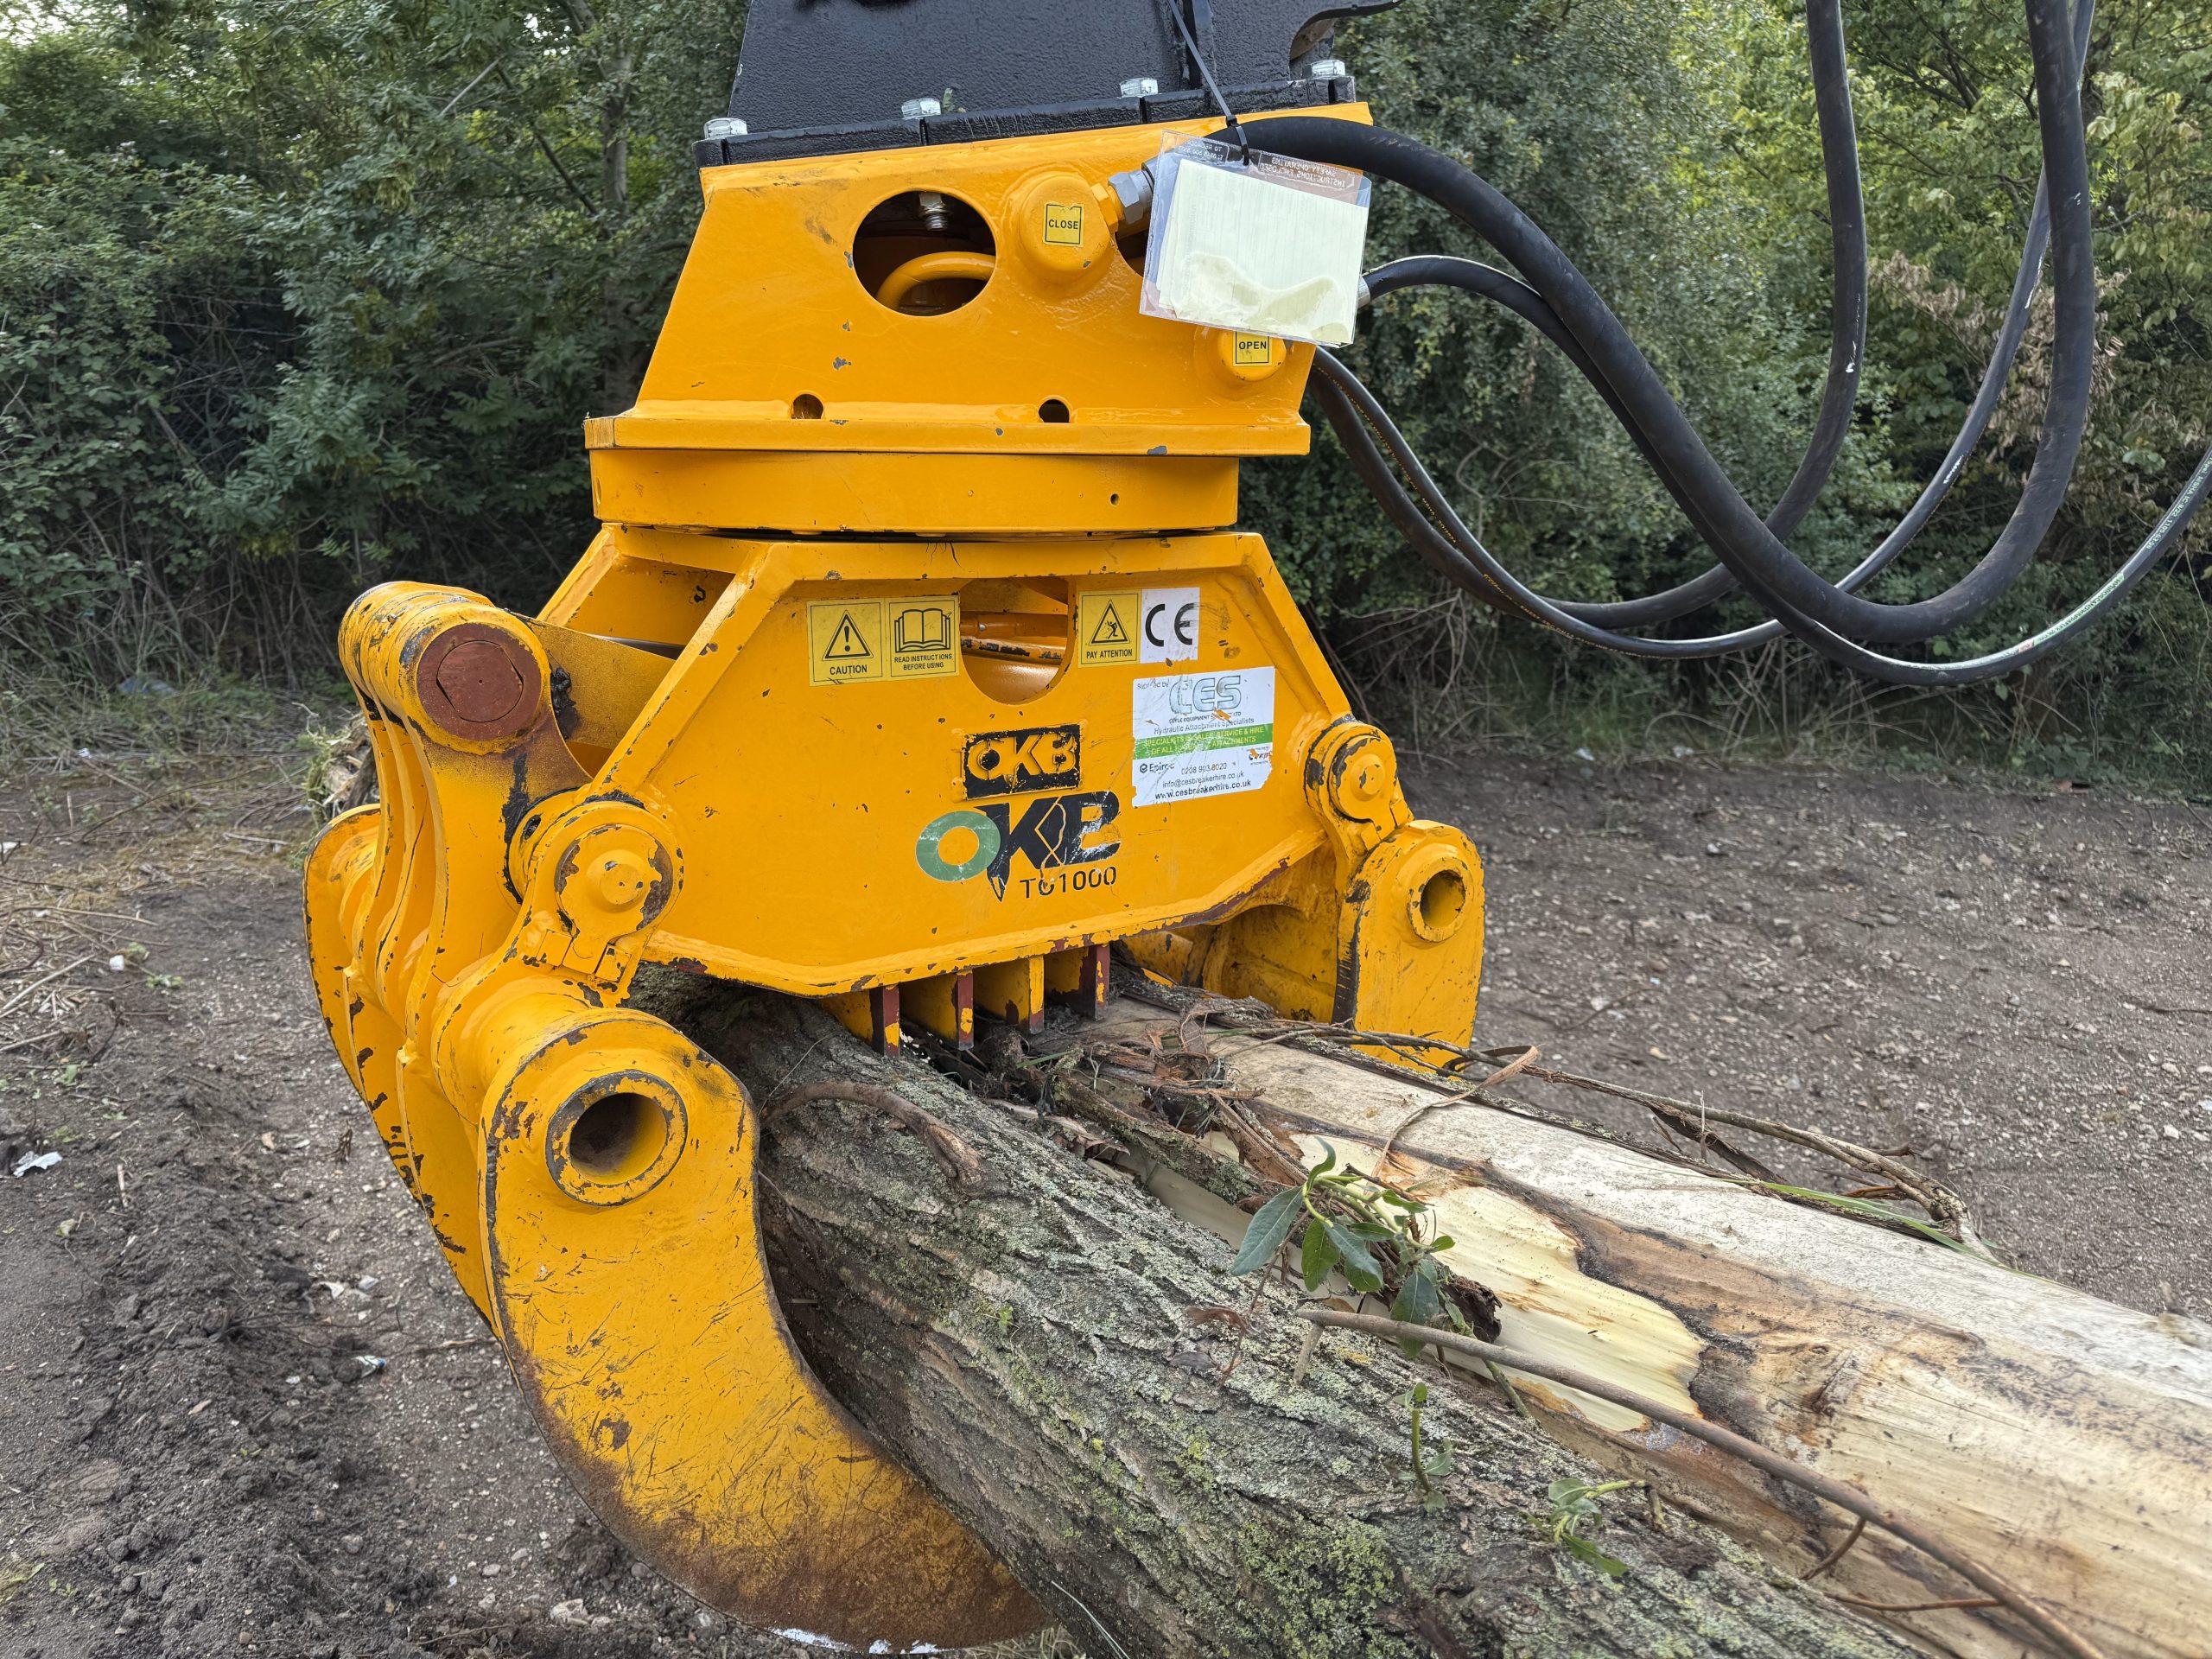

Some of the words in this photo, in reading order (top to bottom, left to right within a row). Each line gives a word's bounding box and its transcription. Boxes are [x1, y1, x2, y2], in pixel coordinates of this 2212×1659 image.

[1048, 219, 1079, 230] CLOSE
[1238, 340, 1268, 350] OPEN
[2186, 475, 2203, 495] MSHA
[1145, 601, 1195, 647] CE
[1086, 650, 1098, 659] PAY
[1100, 649, 1133, 658] ATTENTION
[830, 664, 868, 676] CAUTION
[1169, 675, 1242, 715] CES
[1154, 725, 1184, 734] Hydraulic
[1185, 721, 1221, 732] Attachment
[1222, 718, 1255, 728] Specialists
[1217, 729, 1243, 738] SERVICE
[1211, 737, 1256, 748] ATTACHMENTS
[1180, 766, 1198, 776] 0208
[1162, 770, 1245, 789] info@cesbreakerhire.co.uk
[1154, 779, 1252, 800] www.cesbreakerhire.co.uk
[916, 790, 1122, 902] OKB
